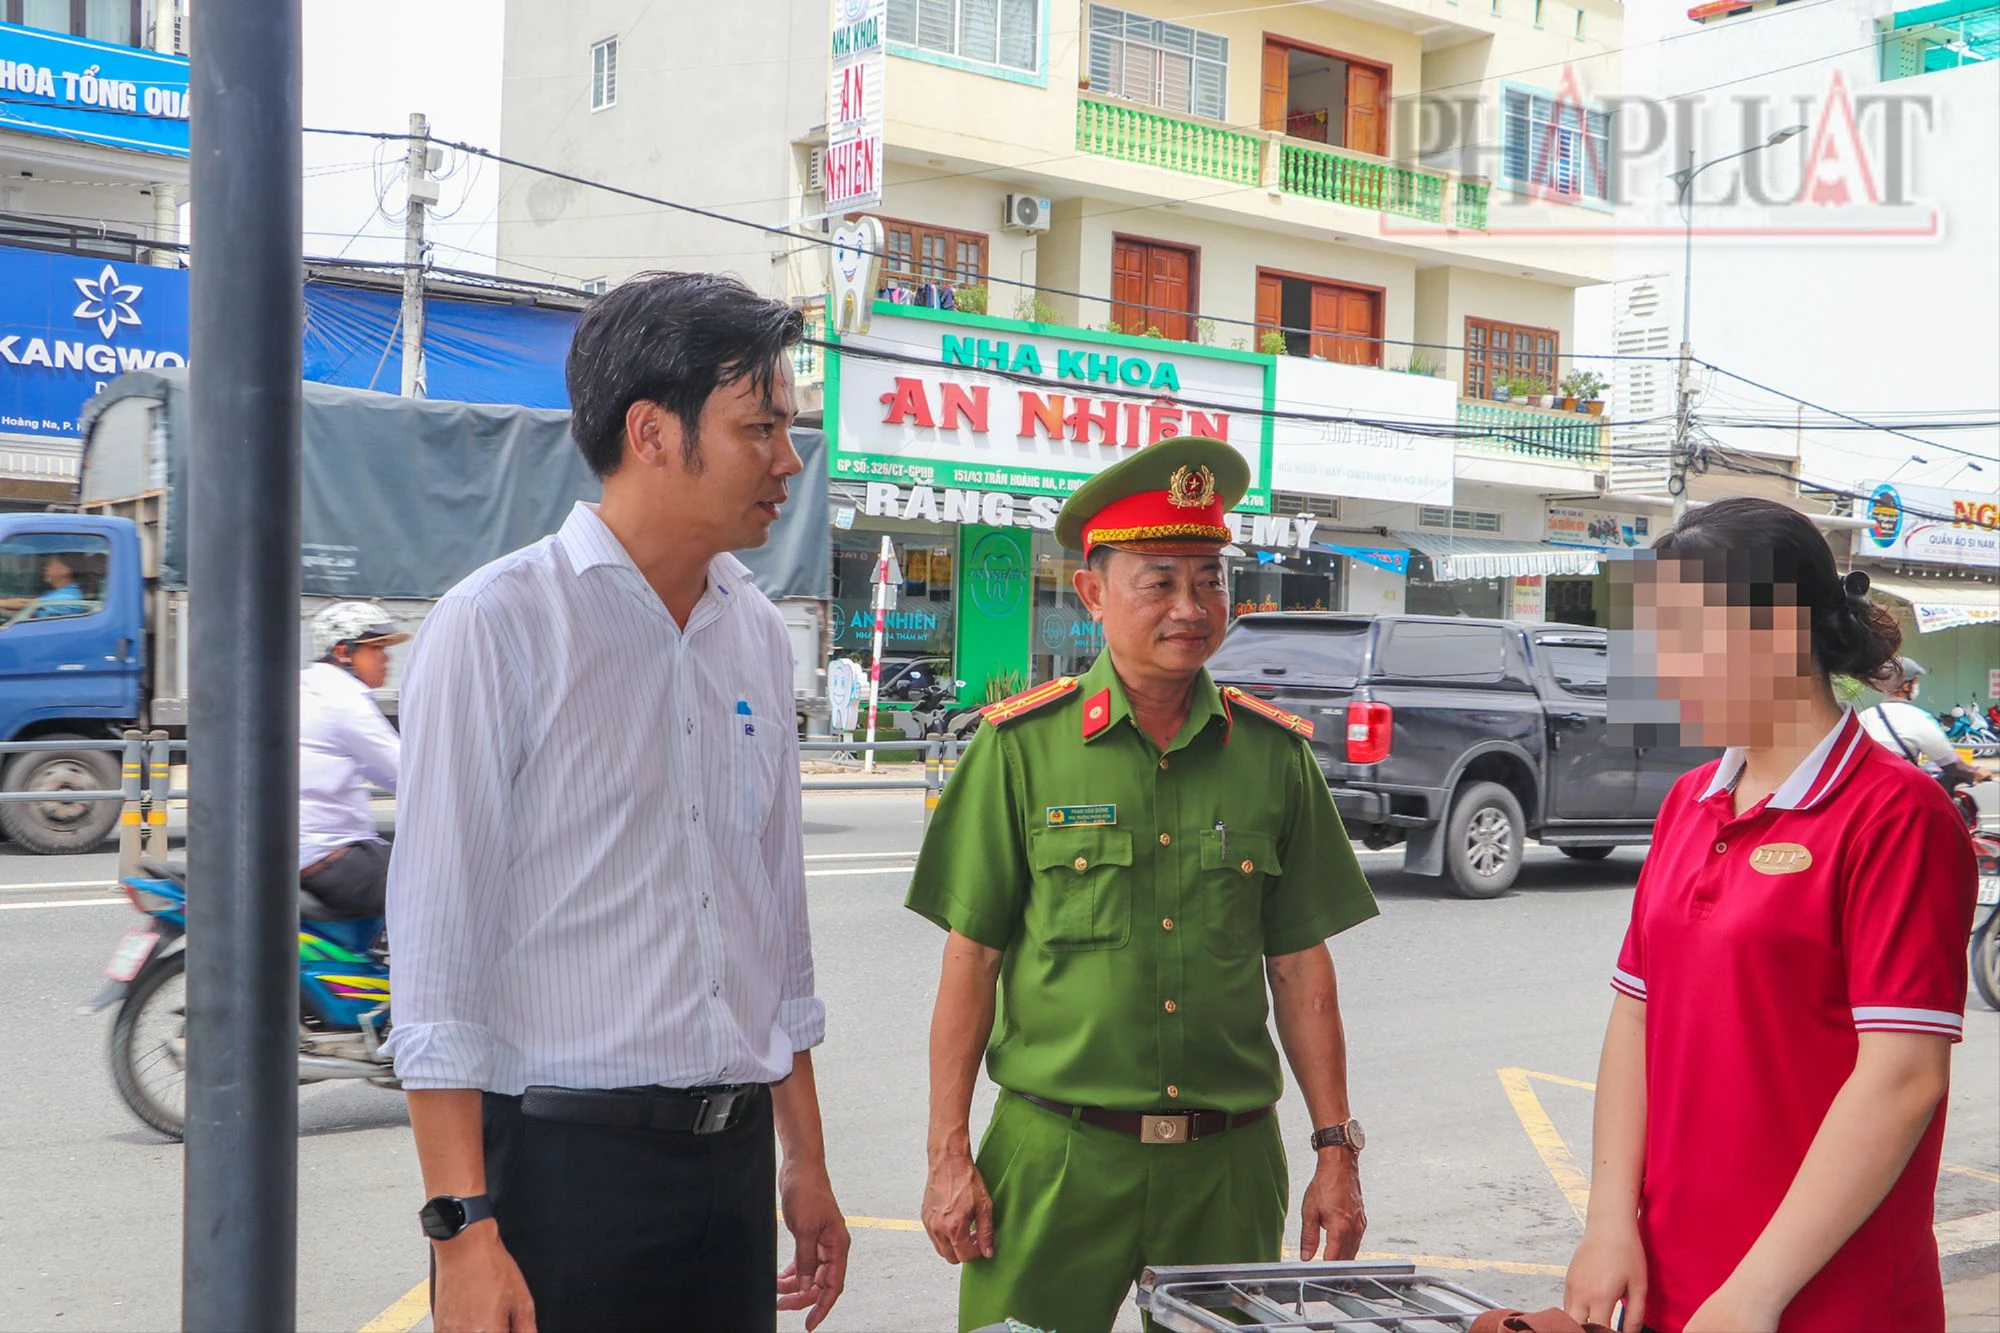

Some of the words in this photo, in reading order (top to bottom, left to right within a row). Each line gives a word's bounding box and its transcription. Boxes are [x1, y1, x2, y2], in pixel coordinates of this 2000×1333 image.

[832, 26, 851, 59] NHA
[853, 15, 879, 52] KHOA
[62, 64, 137, 113] TỔNG
[839, 63, 865, 123] AN
[825, 127, 875, 204] NHIÊN
[0, 335, 190, 374] KANGWO
[941, 334, 1043, 375] NHA
[1057, 348, 1181, 392] KHOA
[1, 415, 39, 430] Hoàng
[879, 376, 991, 433] AN
[1016, 391, 1231, 448] NHIÊN
[837, 459, 851, 472] GP
[953, 469, 983, 483] 151/43
[865, 477, 1014, 527] RĂNG
[1027, 495, 1067, 530] S
[1252, 512, 1319, 549] MỸ
[885, 610, 937, 631] NHIÊN
